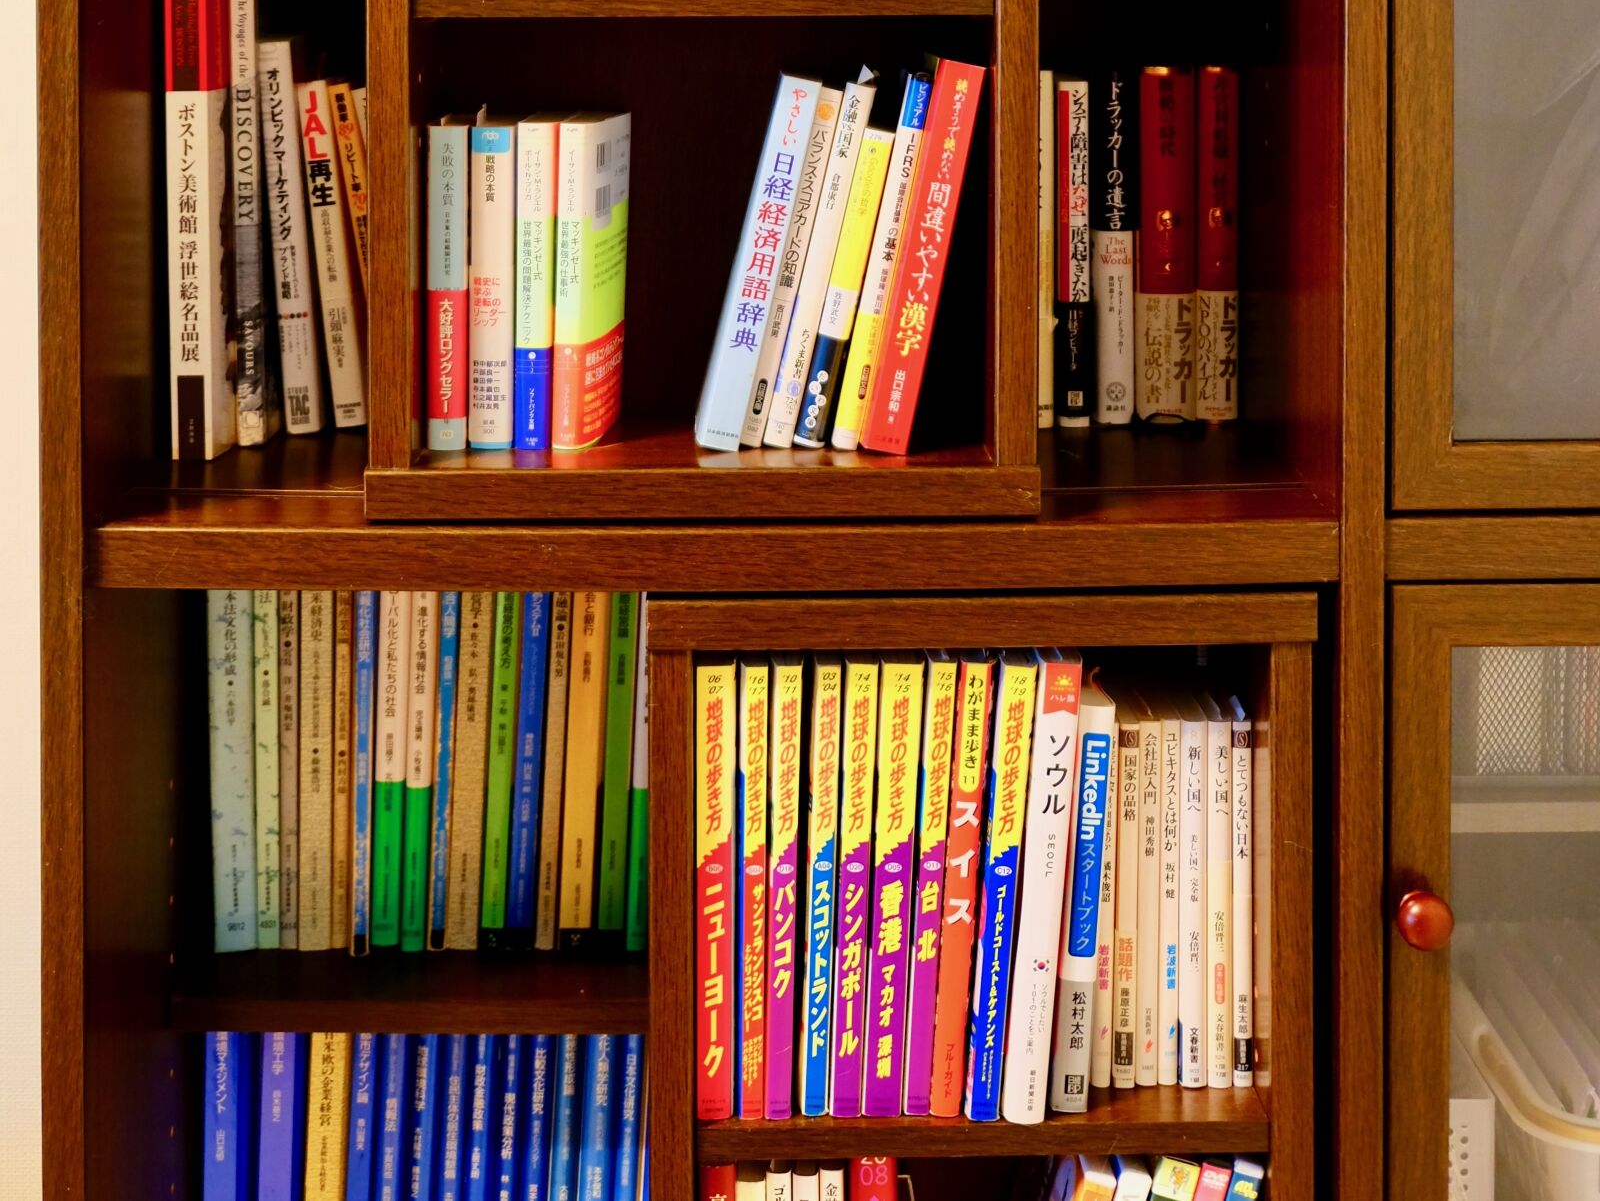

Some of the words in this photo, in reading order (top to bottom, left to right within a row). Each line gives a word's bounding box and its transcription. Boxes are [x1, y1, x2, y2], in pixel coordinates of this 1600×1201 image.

[236, 12, 248, 49] Voyages
[239, 50, 248, 63] of
[237, 64, 248, 79] the
[911, 84, 927, 126] ビジュアル
[236, 88, 253, 222] DISCOVERY
[304, 90, 337, 207] JAL再生
[783, 87, 807, 146] やさしい
[937, 78, 969, 179] 読めそうで読めない
[1105, 82, 1127, 229] ドラッカーの遺言
[177, 102, 198, 234] ボストン美術館
[442, 143, 454, 206] 失敗の本質
[485, 155, 495, 202] 戦略の本質
[1070, 90, 1088, 303] システム障害はなぜ二度起きたか
[533, 221, 542, 281] マッキンゼー式
[570, 221, 580, 283] マッキンゼー式
[730, 152, 795, 353] 日経経済用語辞典
[896, 182, 952, 356] 間違いやすい漢字
[180, 241, 199, 362] 浮世絵名品展
[439, 298, 454, 413] 大好評ロングセラー
[793, 328, 810, 379] ちくま新書
[1174, 298, 1194, 404] ドラッカー
[1197, 296, 1212, 402] NPOのバイブル
[1219, 296, 1238, 402] ドラッカー
[288, 395, 310, 417] TAC
[888, 370, 906, 412] 出口宗和
[926, 694, 952, 831] 地球の歩き方
[964, 675, 984, 769] わがまま歩き
[706, 696, 723, 835] 地球の歩き方
[747, 698, 764, 836] 地球の歩き方
[778, 697, 797, 835] 地球の歩き方
[816, 694, 837, 832] 地球の歩き方
[848, 695, 870, 833] 地球の歩き方
[998, 700, 1025, 836] 地球の歩き方
[1042, 734, 1070, 815] ソウル
[1080, 740, 1107, 840] LinkedIn
[1123, 755, 1136, 821] 国家の品格
[1144, 733, 1157, 805] 会社法入門
[1188, 746, 1201, 812] 新しい国へ
[1216, 746, 1228, 816] 美しい国へ
[1145, 816, 1155, 857] 神田秀樹
[1236, 755, 1249, 859] とてつもない日本
[946, 800, 979, 925] スイス
[1045, 834, 1056, 877] SEOUL
[1190, 834, 1198, 871] 美しい国へ
[1190, 879, 1199, 902] 完全版
[877, 879, 904, 956] 香港
[917, 881, 940, 962] 台北
[1076, 842, 1096, 952] スタートブック
[752, 883, 764, 1021] サンフランシスコ
[773, 879, 795, 999] バンコク
[811, 880, 830, 1057] スコットランド
[838, 883, 864, 1057] シンガポール
[1099, 944, 1109, 991] 岩波新書
[1118, 937, 1133, 983] 話題作
[1167, 944, 1176, 990] 岩波新書
[703, 883, 725, 1078] ニューヨーク
[879, 964, 895, 1028] マカオ
[1069, 991, 1087, 1050] 松村太郎
[1120, 988, 1130, 1028] 藤原正彦
[1238, 994, 1248, 1034] 麻生太郎
[623, 1054, 636, 1121] 日本文化研究
[876, 1034, 892, 1079] 深圳
[860, 1166, 888, 1185] 08
